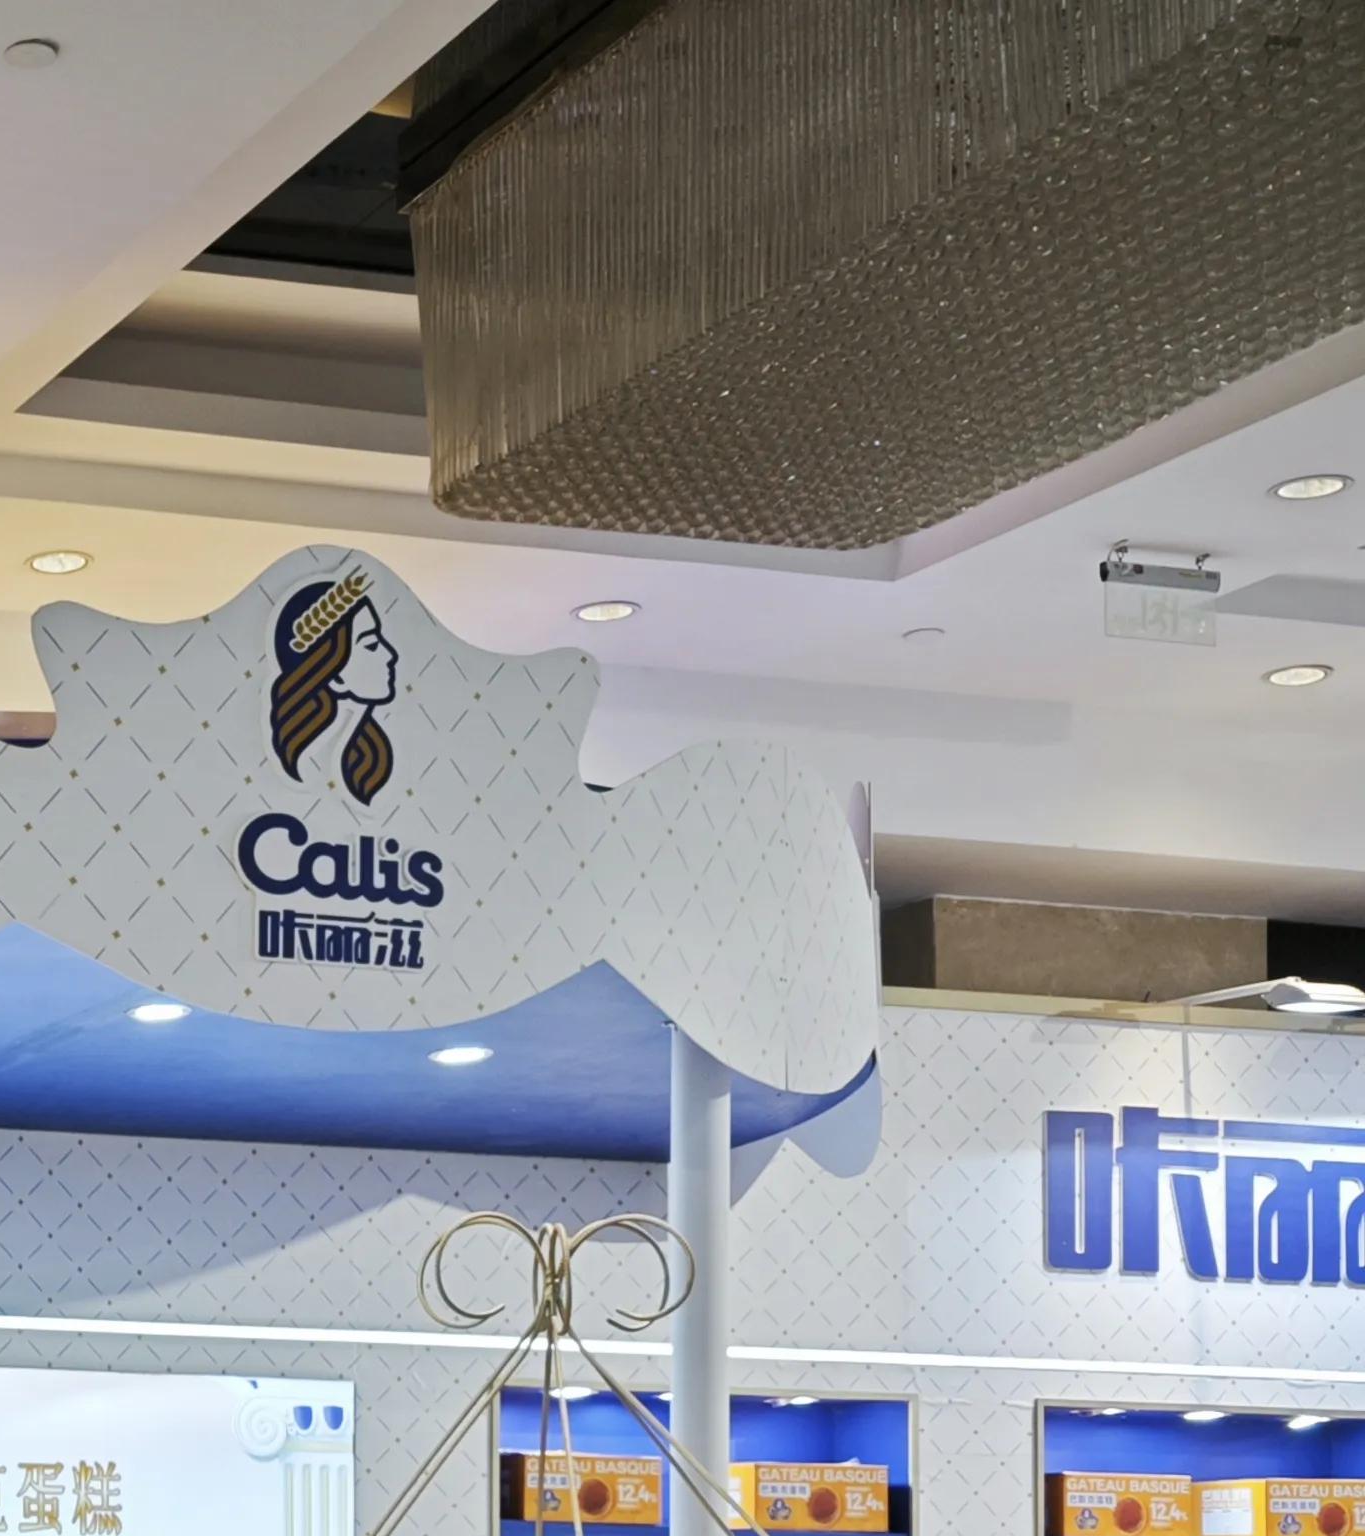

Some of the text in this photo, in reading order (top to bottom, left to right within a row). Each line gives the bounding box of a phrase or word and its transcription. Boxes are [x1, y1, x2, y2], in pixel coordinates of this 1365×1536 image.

[238, 813, 443, 907] Calis
[596, 1460, 661, 1475] BASQUE
[759, 1468, 887, 1483] GATEAU BASQUE
[1066, 1478, 1189, 1494] GATEAU BASQUE
[1270, 1484, 1365, 1498] GATEAU BAS
